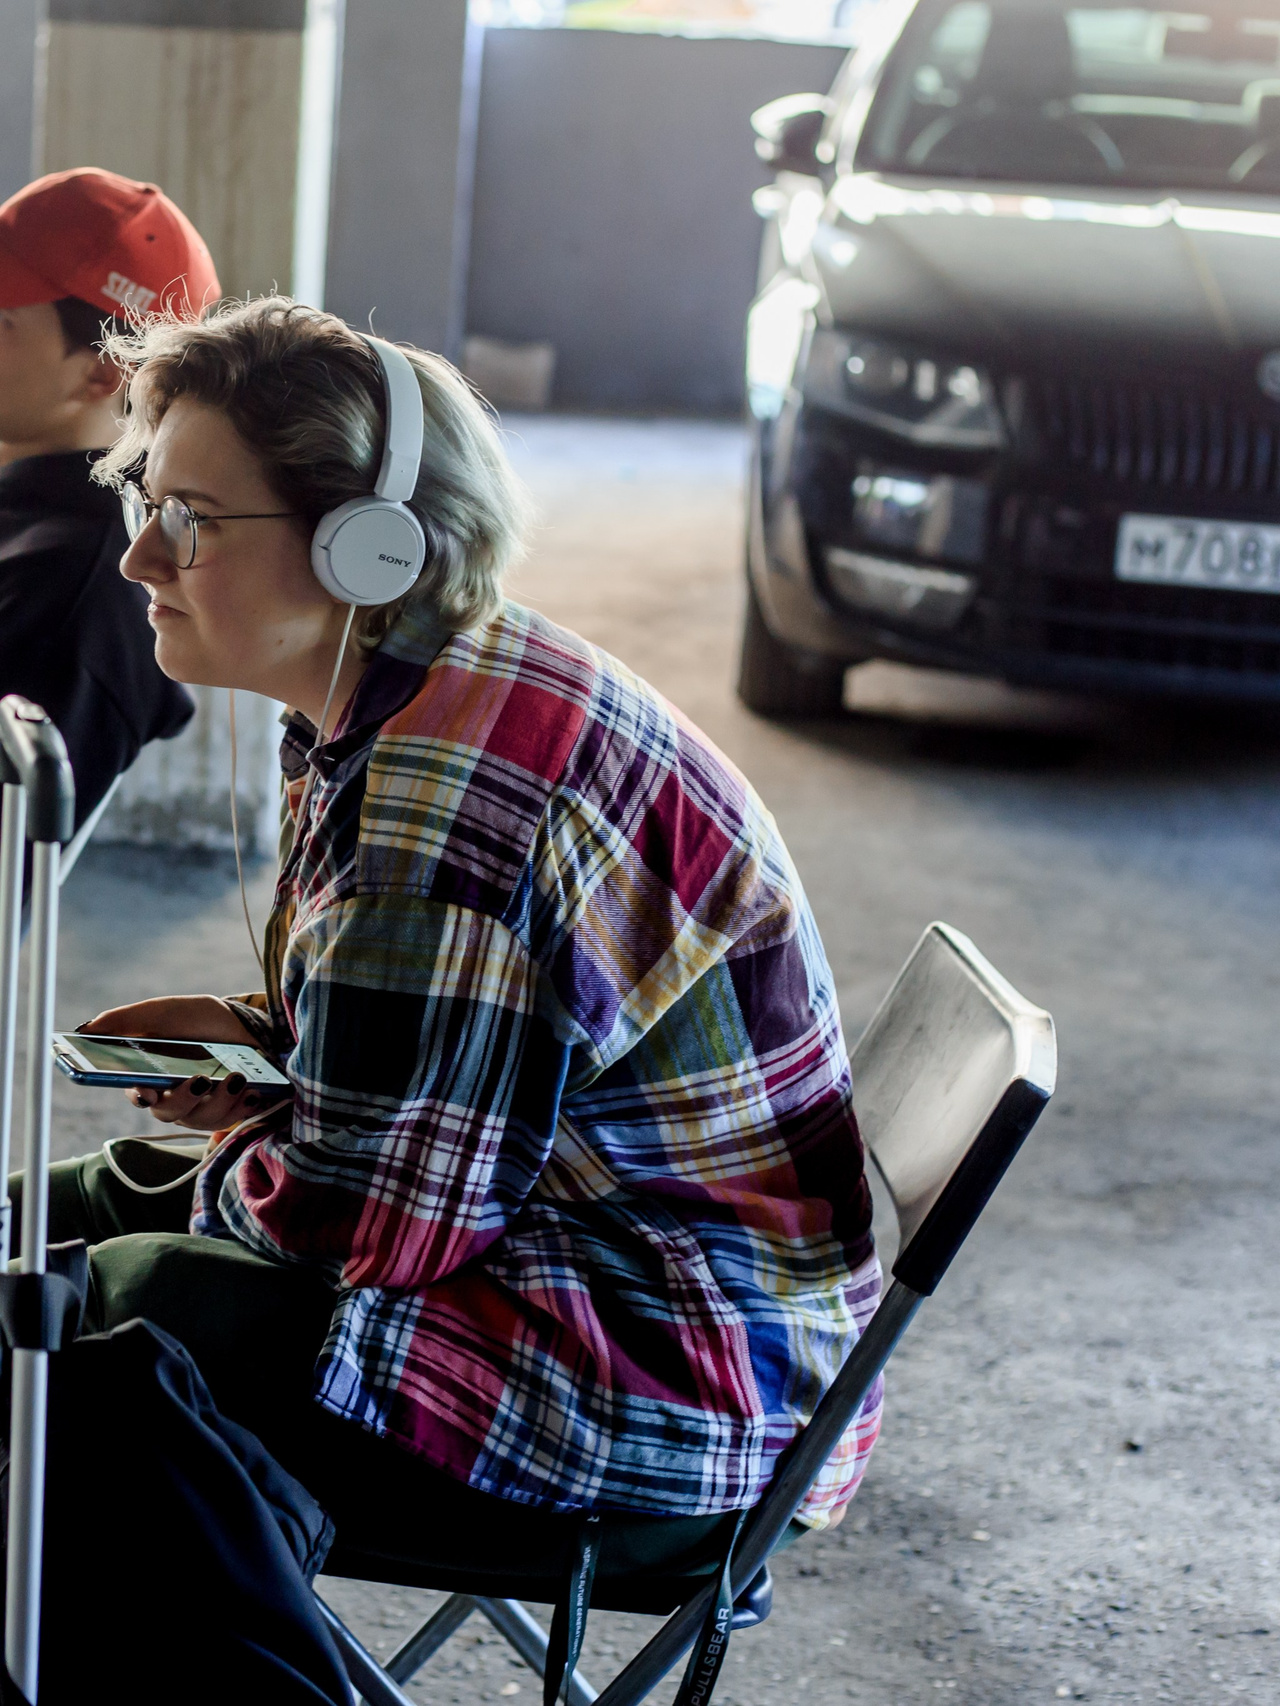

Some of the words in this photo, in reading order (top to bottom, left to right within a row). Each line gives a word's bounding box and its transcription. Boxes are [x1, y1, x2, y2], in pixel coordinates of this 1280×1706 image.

[378, 553, 411, 568] SONY
[577, 1580, 586, 1607] FUTURE
[691, 1607, 730, 1706] PULL&BEAR
